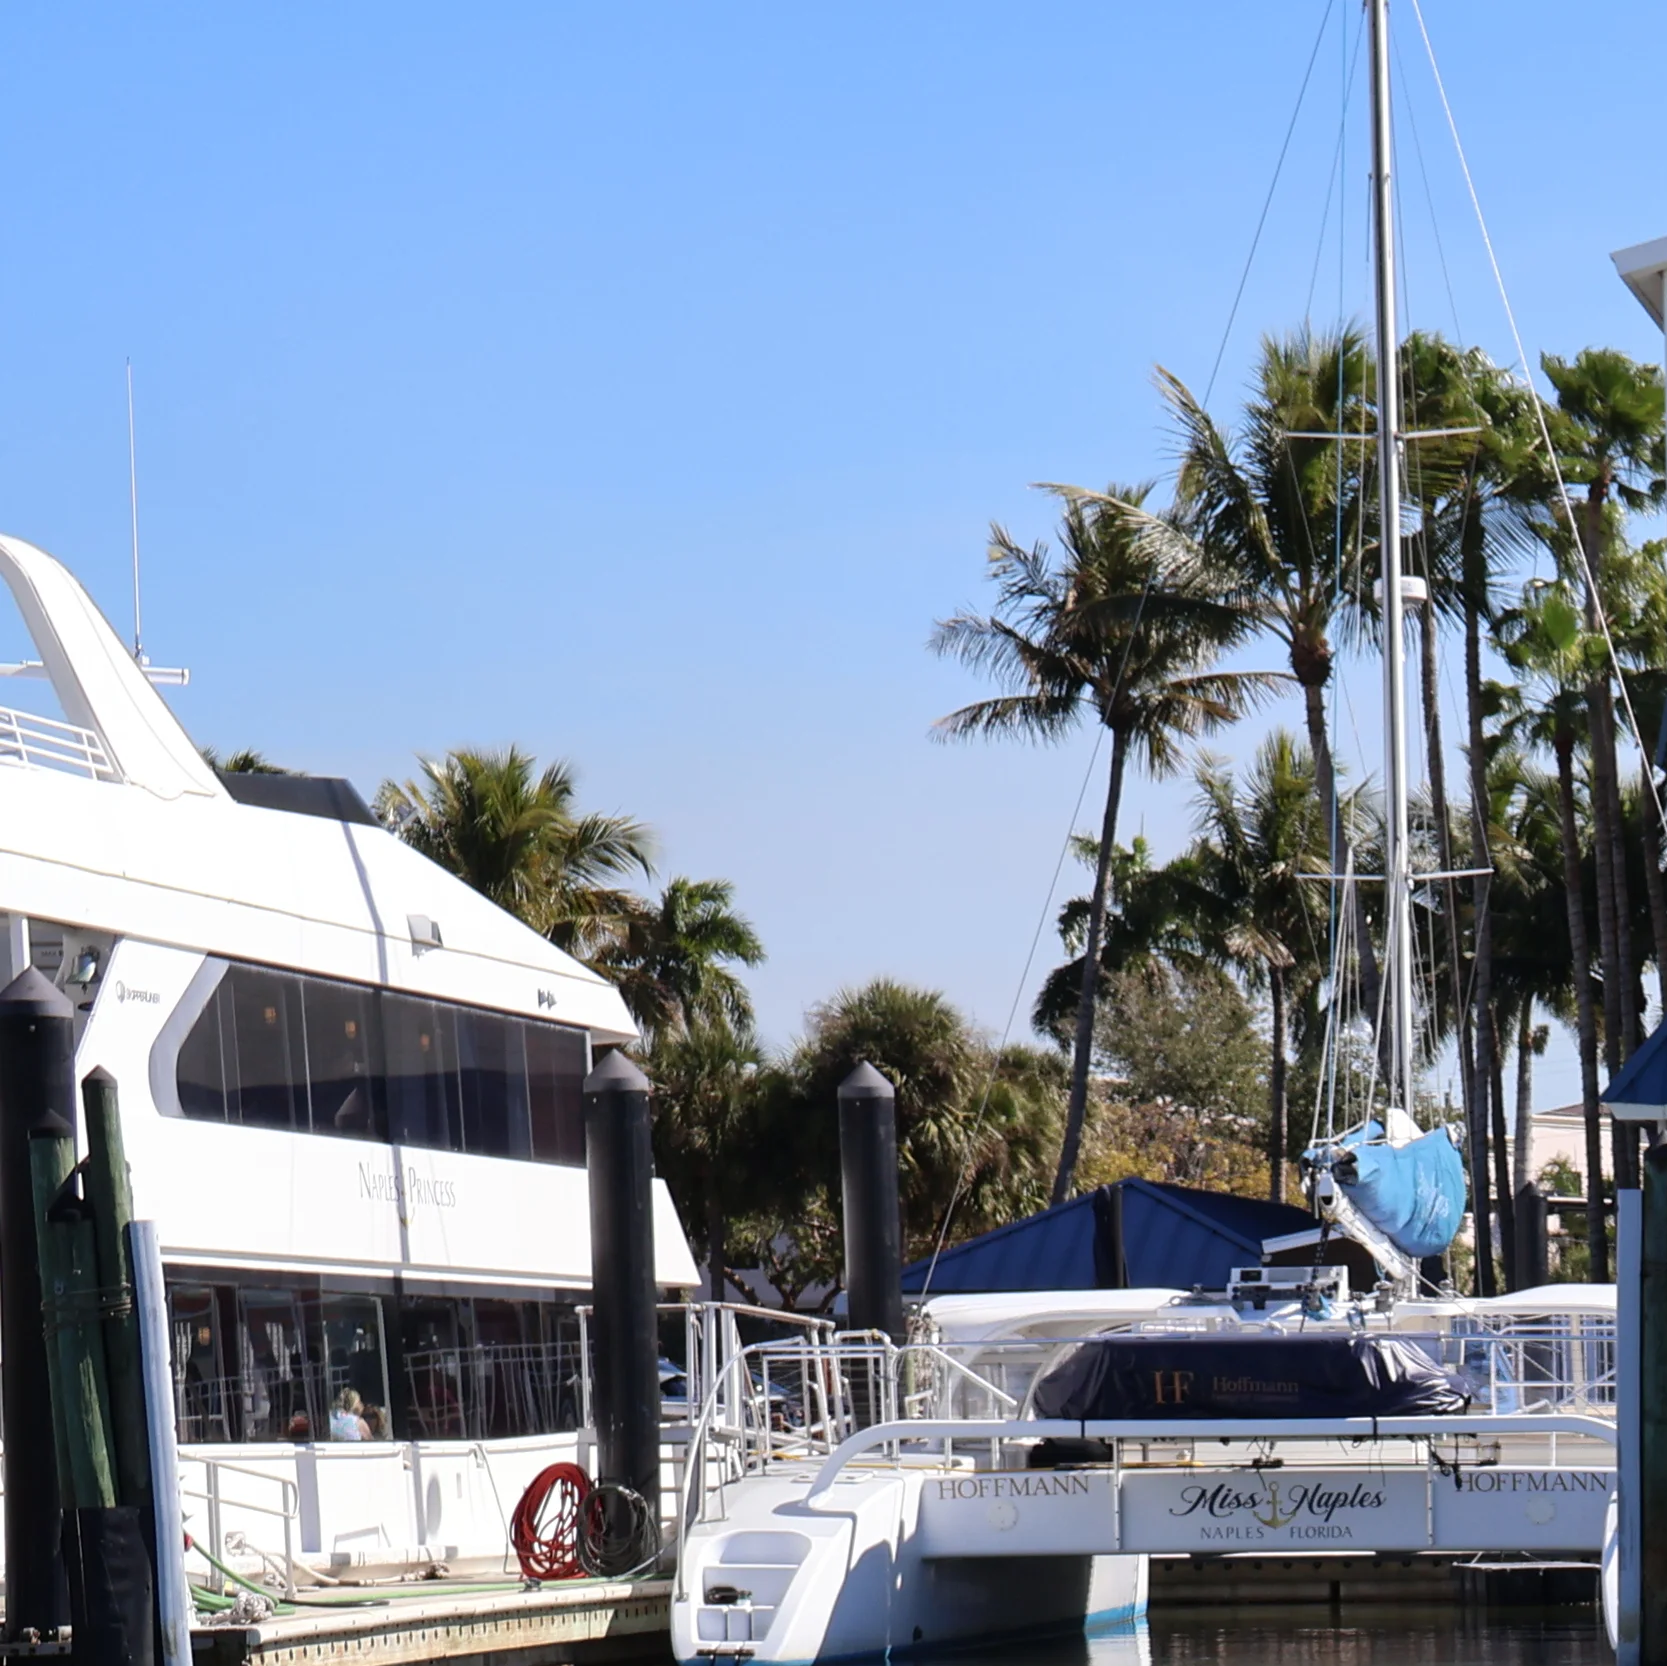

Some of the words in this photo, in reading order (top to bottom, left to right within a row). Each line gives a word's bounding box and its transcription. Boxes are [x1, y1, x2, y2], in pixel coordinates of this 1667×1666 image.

[359, 1161, 401, 1202] NAPLES
[408, 1166, 456, 1207] PRINCESS
[1212, 1376, 1299, 1393] Hoffmann
[938, 1474, 1090, 1500] HOFFMANN
[1456, 1472, 1609, 1493] HOFFMANN
[1169, 1483, 1264, 1518] Miss
[1279, 1483, 1387, 1522] Naples
[1200, 1526, 1265, 1540] NAPLES
[1289, 1525, 1353, 1539] FLORIDA
